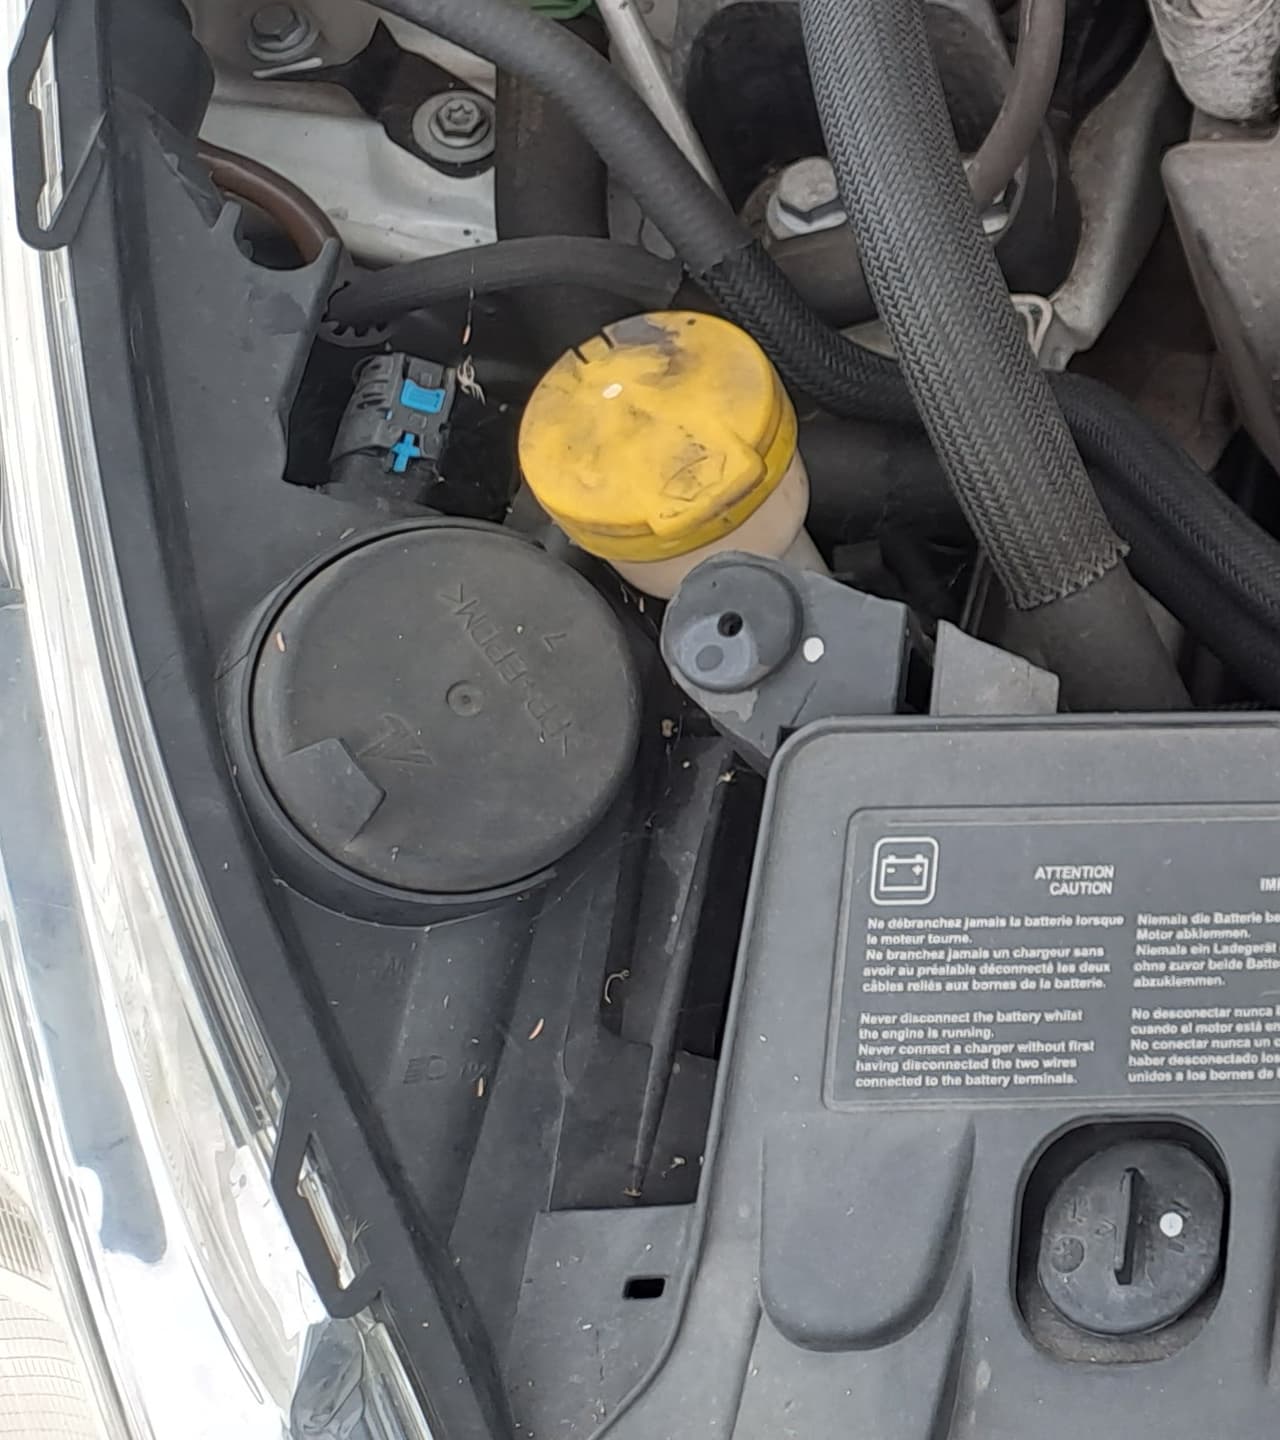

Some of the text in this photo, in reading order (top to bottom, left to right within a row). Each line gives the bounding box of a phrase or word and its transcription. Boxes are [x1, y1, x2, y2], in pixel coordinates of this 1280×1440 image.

[1034, 865, 1114, 879] ATTENTION
[1049, 881, 1112, 895] CAUTION
[867, 916, 884, 930] Ne
[963, 915, 1006, 931] jamais
[1009, 914, 1021, 928] la
[1024, 914, 1072, 927] batterie
[1075, 913, 1124, 929] lorsque
[1137, 912, 1188, 925] Niemals
[1190, 911, 1210, 925] die
[1213, 911, 1262, 924] Batterie
[866, 931, 973, 945] le moteur tourne.
[1135, 926, 1252, 941] Motor abklemmen.
[865, 945, 1104, 962] Ne branchez jamais un chargeur sans
[1135, 942, 1187, 956] Niemals
[1190, 942, 1210, 955] ein
[862, 963, 895, 976] avoir
[898, 965, 914, 976] au
[1056, 961, 1076, 974] les
[1078, 960, 1110, 973] deux
[1133, 959, 1166, 973] ohne
[1168, 960, 1205, 972] zuvor
[1207, 958, 1243, 971] beide
[945, 980, 969, 991] aux
[971, 977, 1017, 991] bornes
[1019, 977, 1036, 990] de
[1039, 977, 1051, 990] la
[1054, 976, 1107, 990] batterie.
[1133, 974, 1226, 989] abzuklemmen.
[860, 1008, 1082, 1025] Never disconnect the battery whilst
[1131, 1006, 1150, 1019] No
[1152, 1005, 1231, 1019] desconectar
[1233, 1006, 1273, 1018] nunca
[858, 1026, 996, 1042] the engine is running.
[1130, 1022, 1178, 1035] cuando
[1180, 1021, 1193, 1035] el
[1195, 1021, 1233, 1034] motor
[1264, 1022, 1280, 1033] en
[858, 1040, 1094, 1057] Never connect a charger without first
[1130, 1038, 1149, 1051] No
[1151, 1037, 1208, 1050] conectar
[1210, 1038, 1251, 1049] nunca
[1253, 1037, 1271, 1049] un
[855, 1056, 1077, 1074] having disconnected the two wires
[1128, 1053, 1165, 1066] haber
[1167, 1052, 1258, 1066] desconectado
[1260, 1051, 1280, 1065] los
[855, 1072, 1079, 1089] connected to the battery terminals.
[1128, 1069, 1172, 1083] unidos
[1175, 1071, 1184, 1082] a
[1186, 1068, 1207, 1082] los
[1209, 1068, 1254, 1081] bornes
[1257, 1067, 1274, 1081] de
